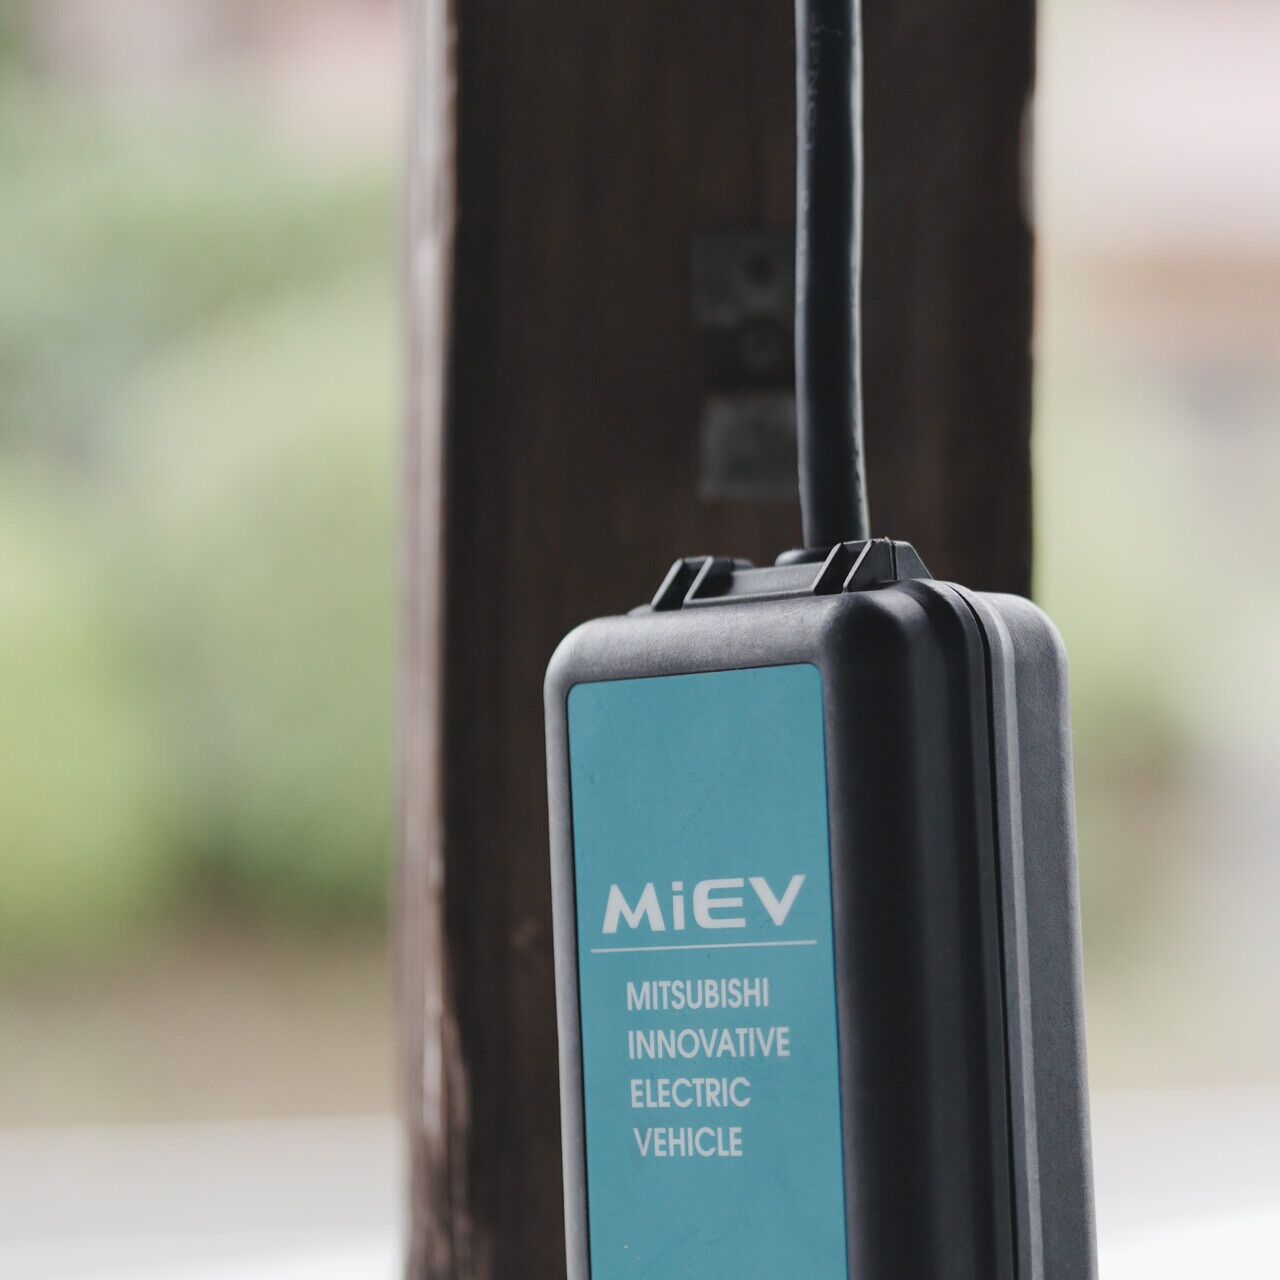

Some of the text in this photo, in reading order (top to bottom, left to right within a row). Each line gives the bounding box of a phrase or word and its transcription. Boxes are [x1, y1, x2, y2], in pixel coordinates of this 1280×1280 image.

[601, 874, 806, 934] MiEV
[626, 977, 770, 1011] MITSUBISHI
[627, 1026, 791, 1060] INNOVATIVE
[630, 1076, 751, 1109] ELECTRIC
[632, 1126, 743, 1158] VEHICLE
